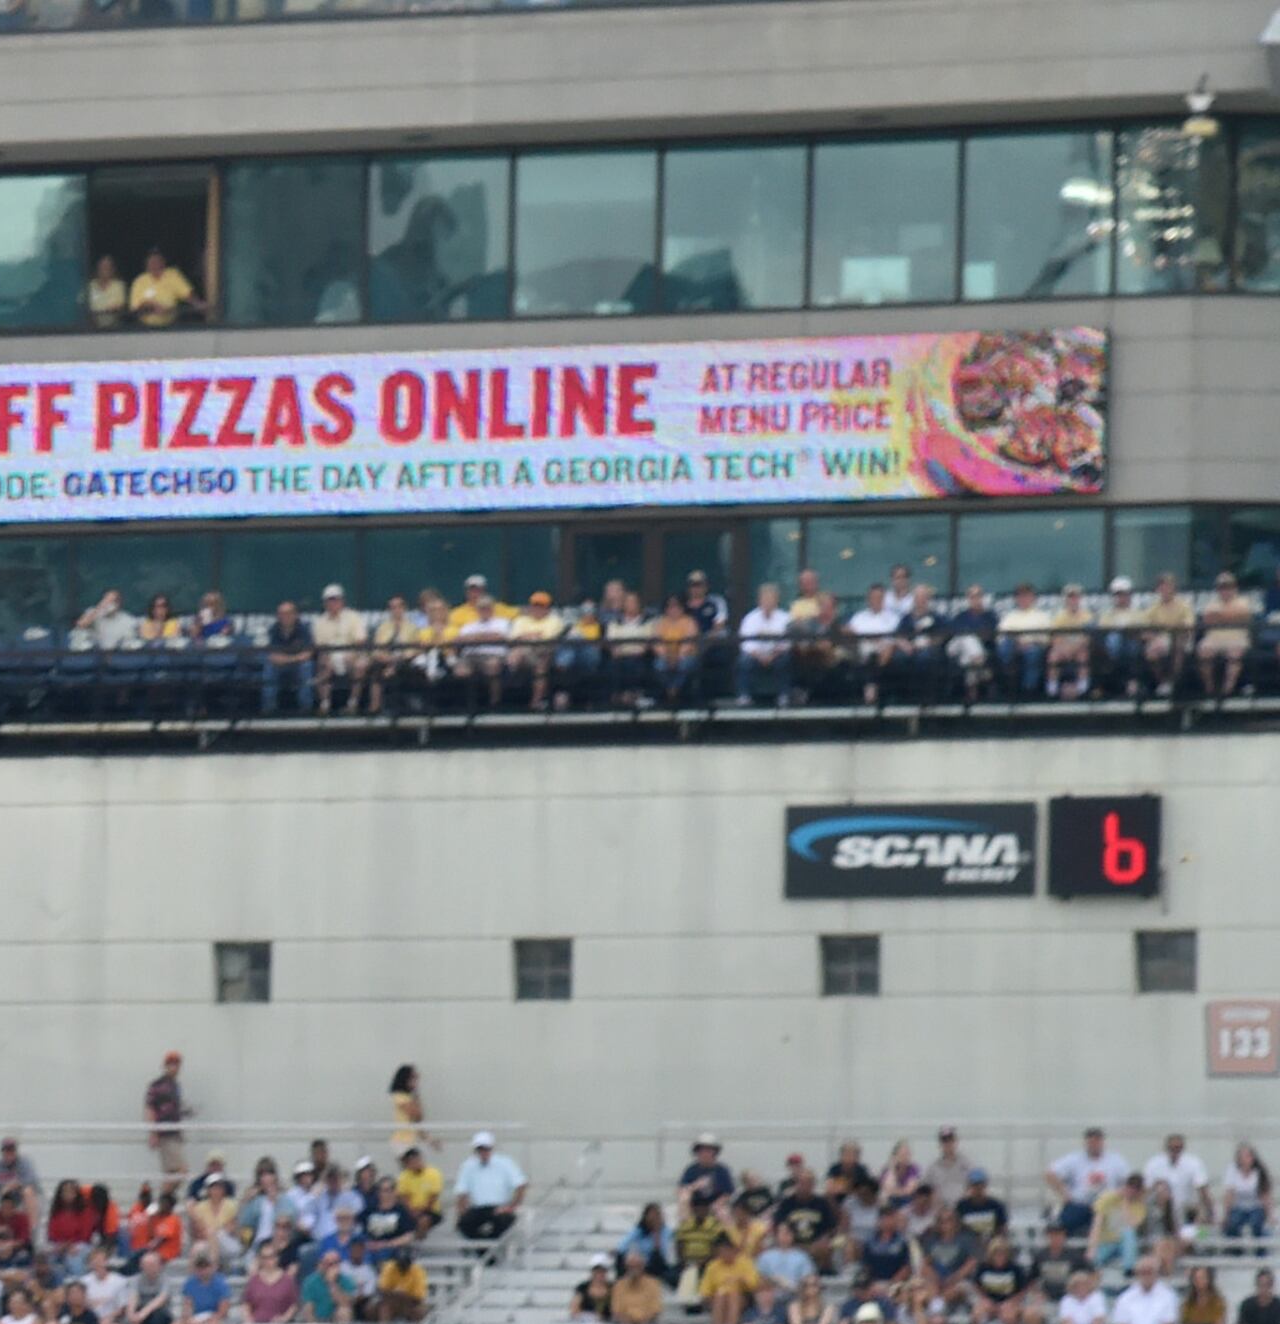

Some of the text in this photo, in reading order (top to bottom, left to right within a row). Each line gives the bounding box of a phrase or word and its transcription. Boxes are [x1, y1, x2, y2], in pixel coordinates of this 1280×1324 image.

[700, 359, 891, 395] AT REGULAR
[95, 374, 354, 449] PIZZAS
[379, 364, 658, 442] ONLINE
[700, 400, 891, 434] MENU PRICE
[64, 469, 236, 496] GATECH50
[248, 467, 308, 493] THE
[321, 464, 384, 490] DAY
[397, 459, 501, 487] AFTER
[513, 460, 531, 486] A
[544, 453, 691, 484] GEORGIA
[822, 449, 901, 478] WIN!
[833, 833, 1022, 868] SCANA
